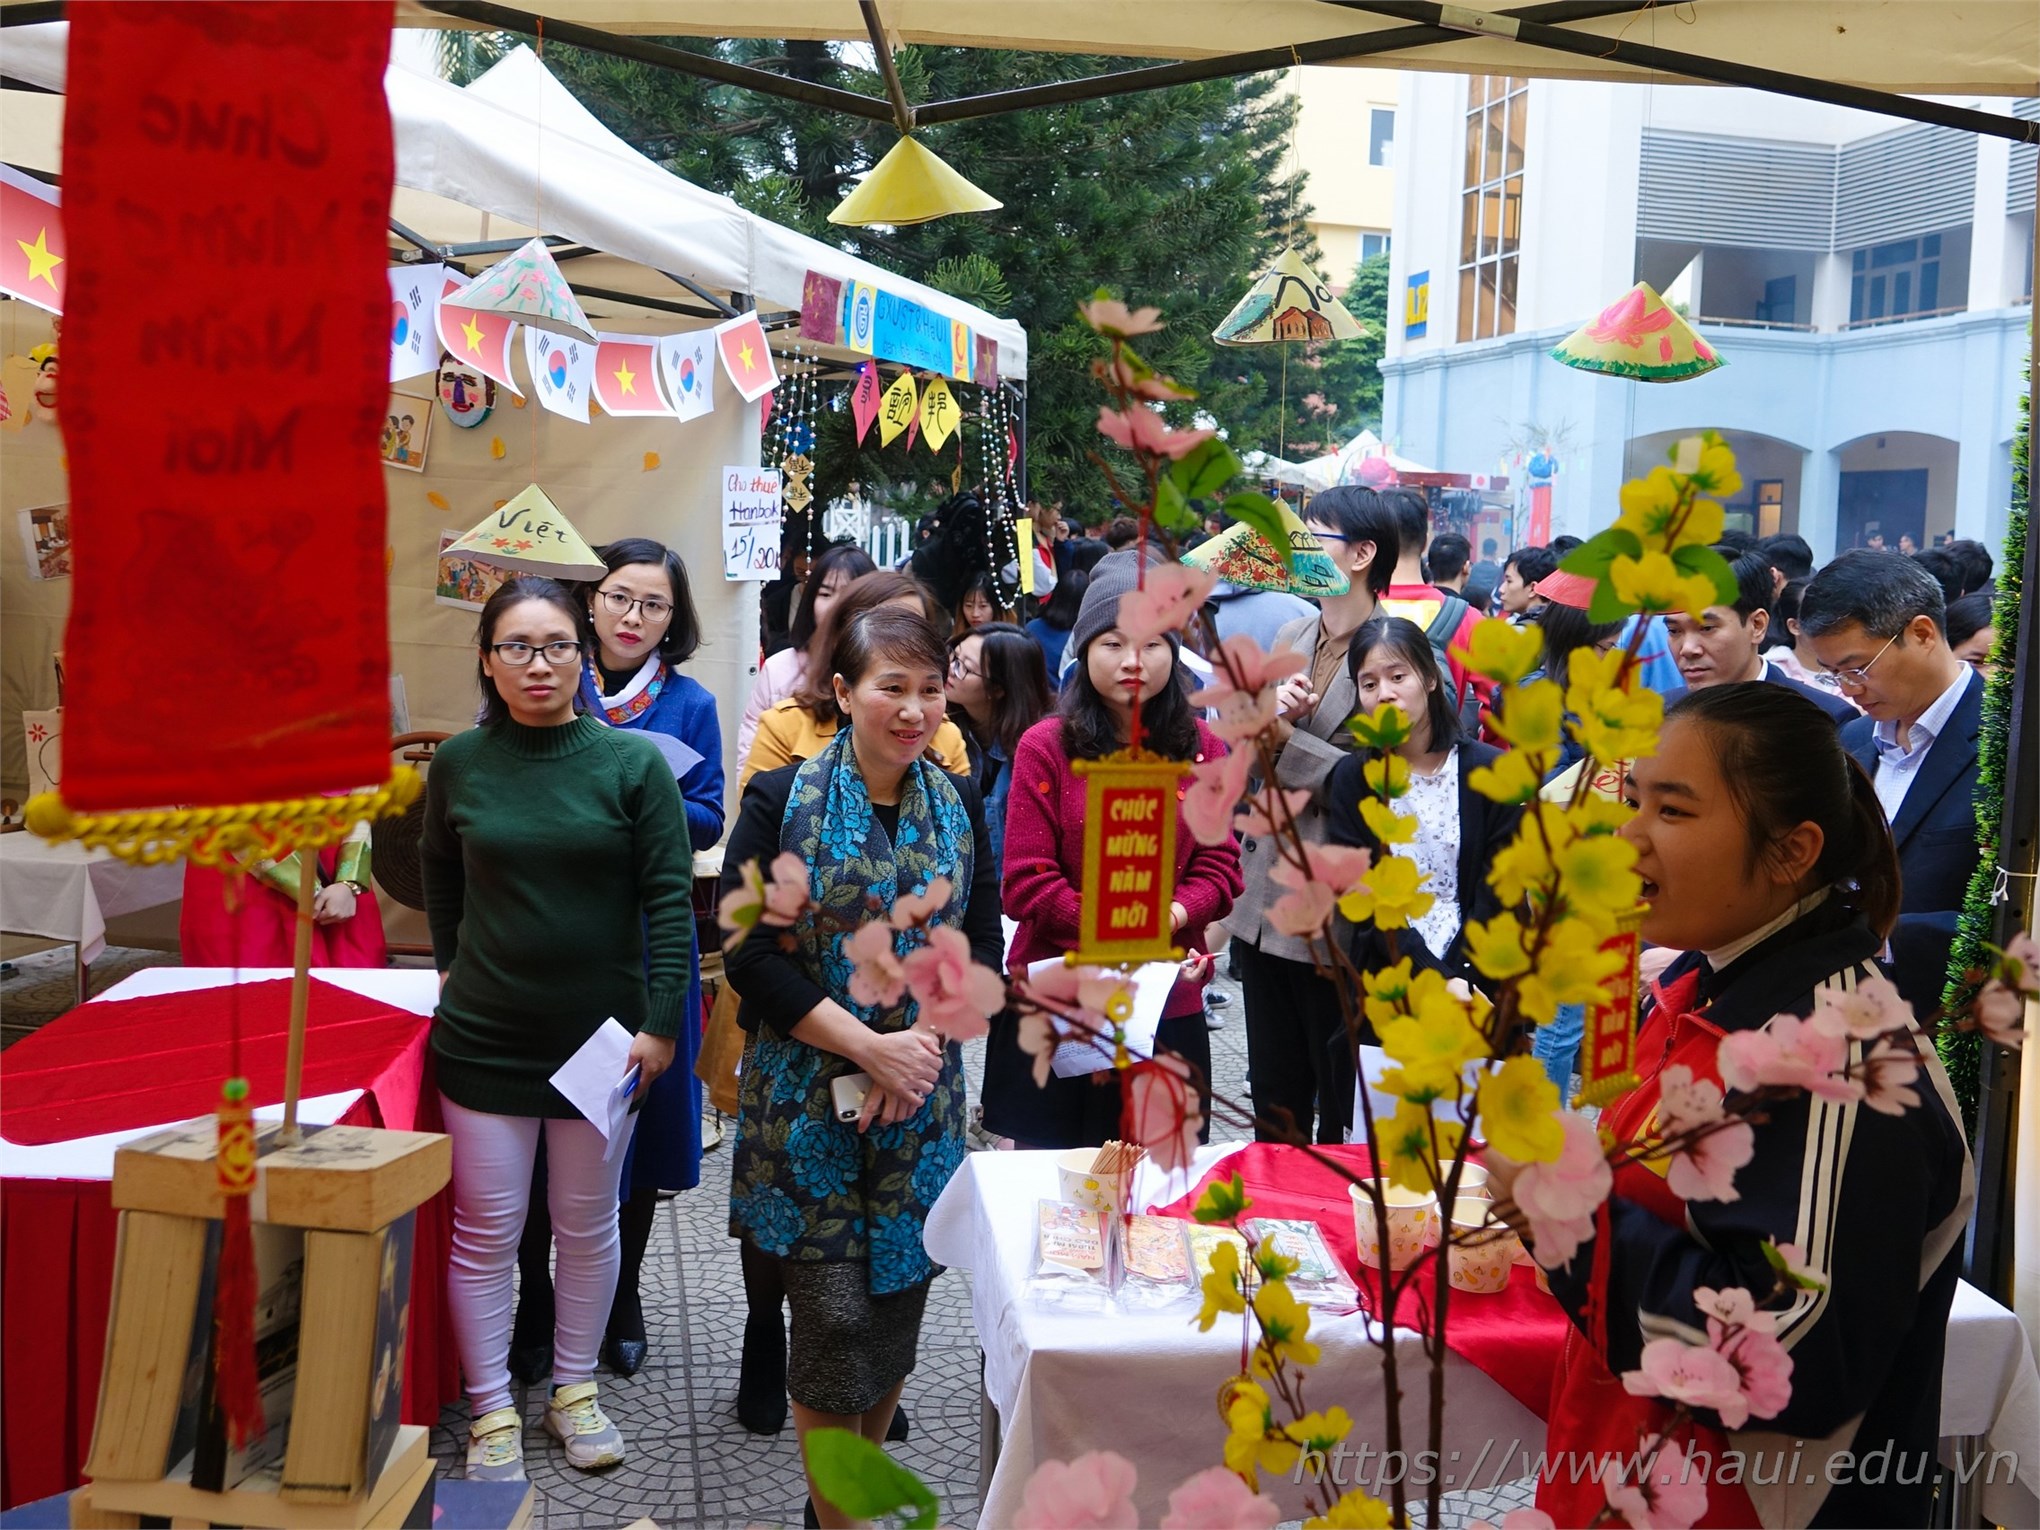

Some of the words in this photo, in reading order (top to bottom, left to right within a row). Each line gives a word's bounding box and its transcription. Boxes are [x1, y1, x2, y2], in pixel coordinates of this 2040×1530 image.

[728, 473, 746, 493] Cho
[729, 498, 779, 521] Hanbok
[498, 508, 570, 544] Việt
[1110, 792, 1158, 822] CHÚC
[1106, 829, 1158, 858] MỪNG
[1109, 865, 1153, 894] NĂM
[1111, 900, 1149, 929] MỚI
